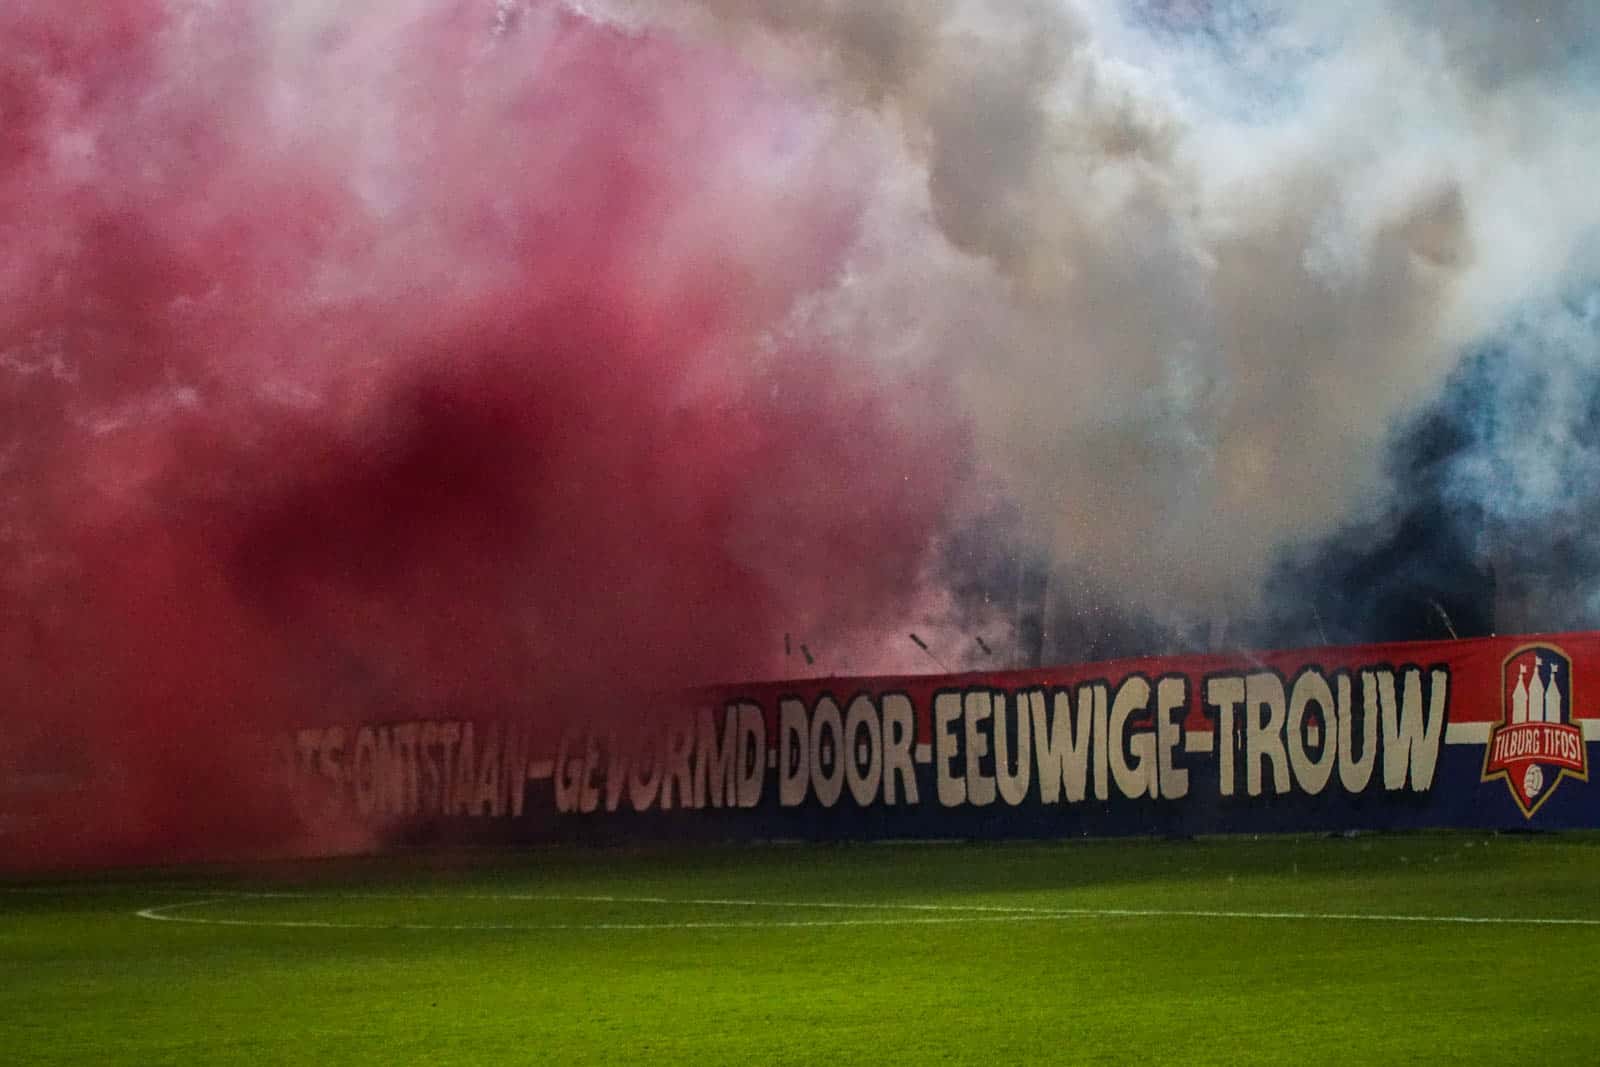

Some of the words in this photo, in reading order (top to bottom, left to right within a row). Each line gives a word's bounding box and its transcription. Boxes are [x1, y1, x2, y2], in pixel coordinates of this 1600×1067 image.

[779, 694, 920, 806] DOOR
[935, 677, 1190, 806] EEUWIGE
[1207, 669, 1448, 797] TROUW
[1494, 728, 1540, 762] TILBURG
[1543, 727, 1582, 761] TIFOSI
